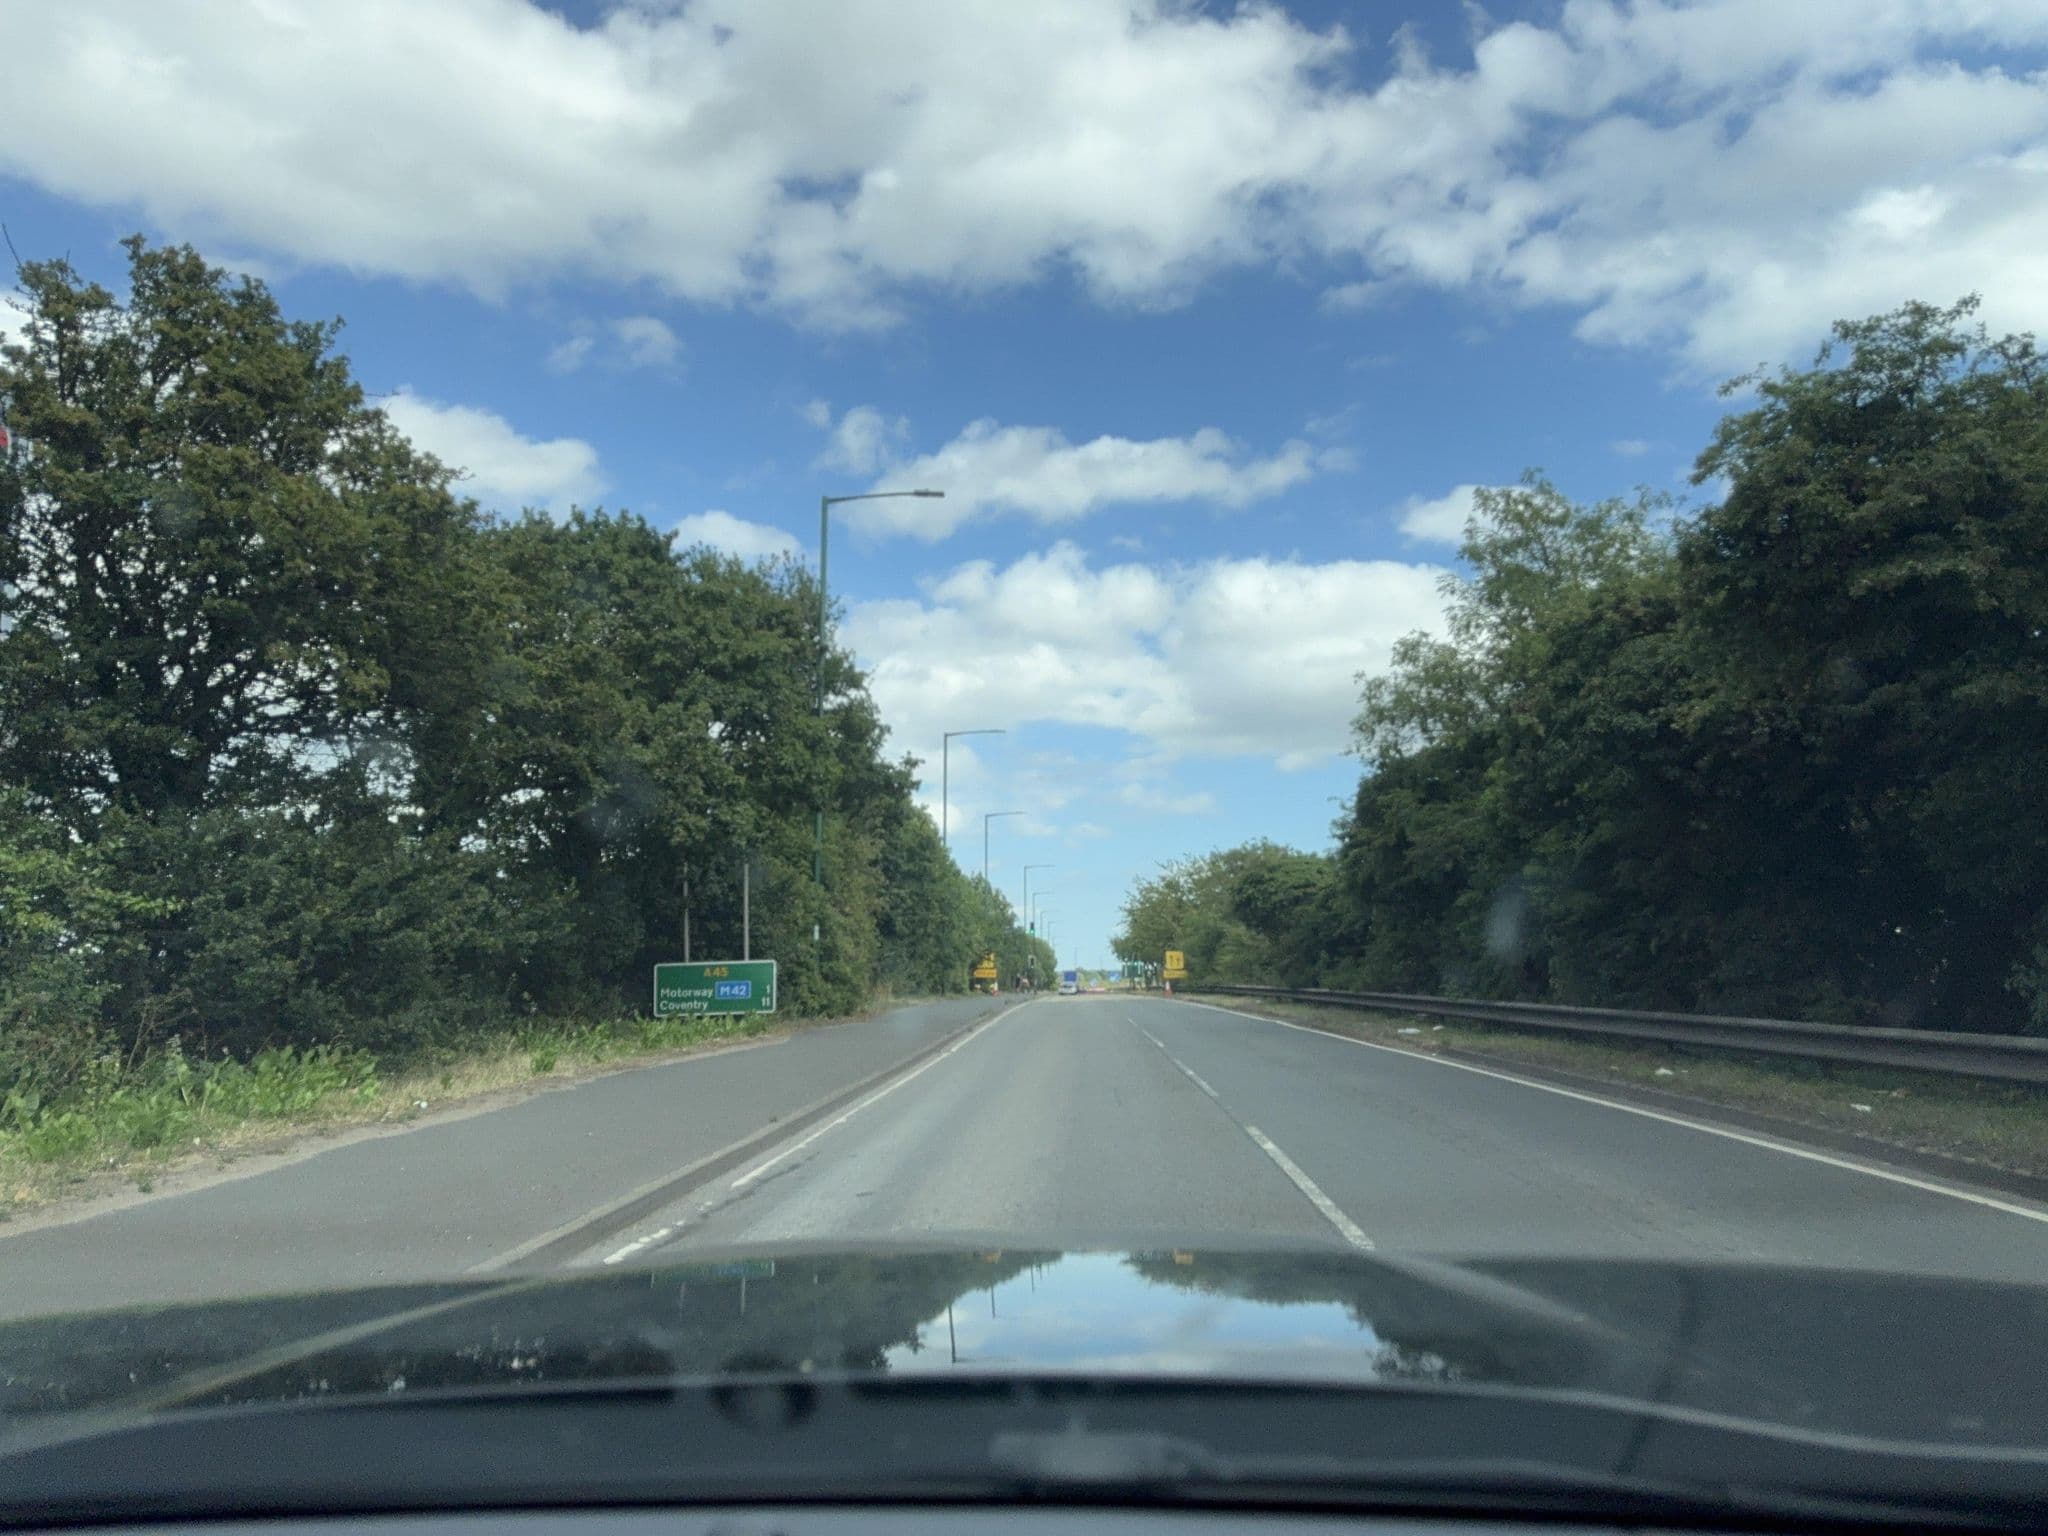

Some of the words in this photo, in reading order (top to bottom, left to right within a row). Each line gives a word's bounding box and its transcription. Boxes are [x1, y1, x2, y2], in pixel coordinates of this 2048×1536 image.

[703, 967, 729, 977] A45
[660, 987, 713, 998] Motorway
[720, 985, 746, 996] M42
[660, 1000, 708, 1011] Coventry
[761, 997, 770, 1007] 11
